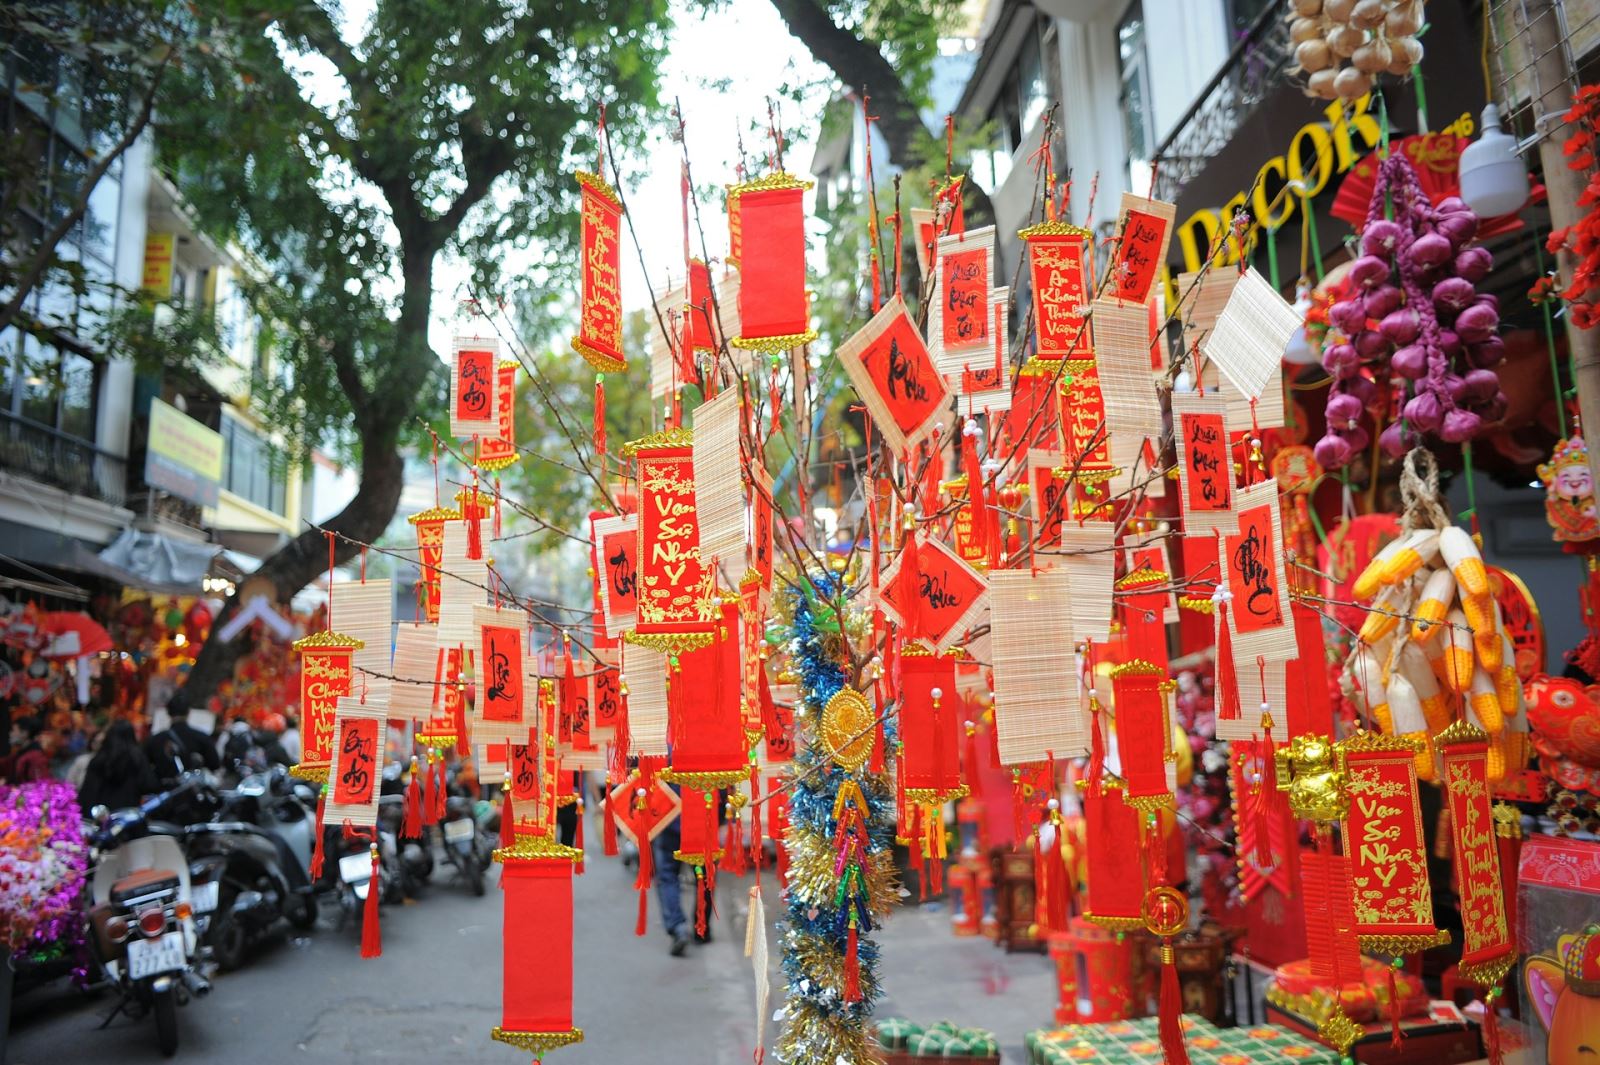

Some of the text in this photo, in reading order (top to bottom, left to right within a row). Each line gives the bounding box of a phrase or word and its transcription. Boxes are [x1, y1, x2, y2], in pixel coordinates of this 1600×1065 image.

[1049, 269, 1069, 287] An
[1040, 287, 1082, 304] Khang
[655, 494, 696, 517] Vạn
[657, 517, 694, 540] Sự
[651, 541, 701, 565] Như
[664, 560, 687, 586] Ý
[1357, 797, 1403, 818] Vạn
[1363, 819, 1401, 842] Sự
[1360, 842, 1412, 867] Như
[1373, 861, 1398, 888] Ý
